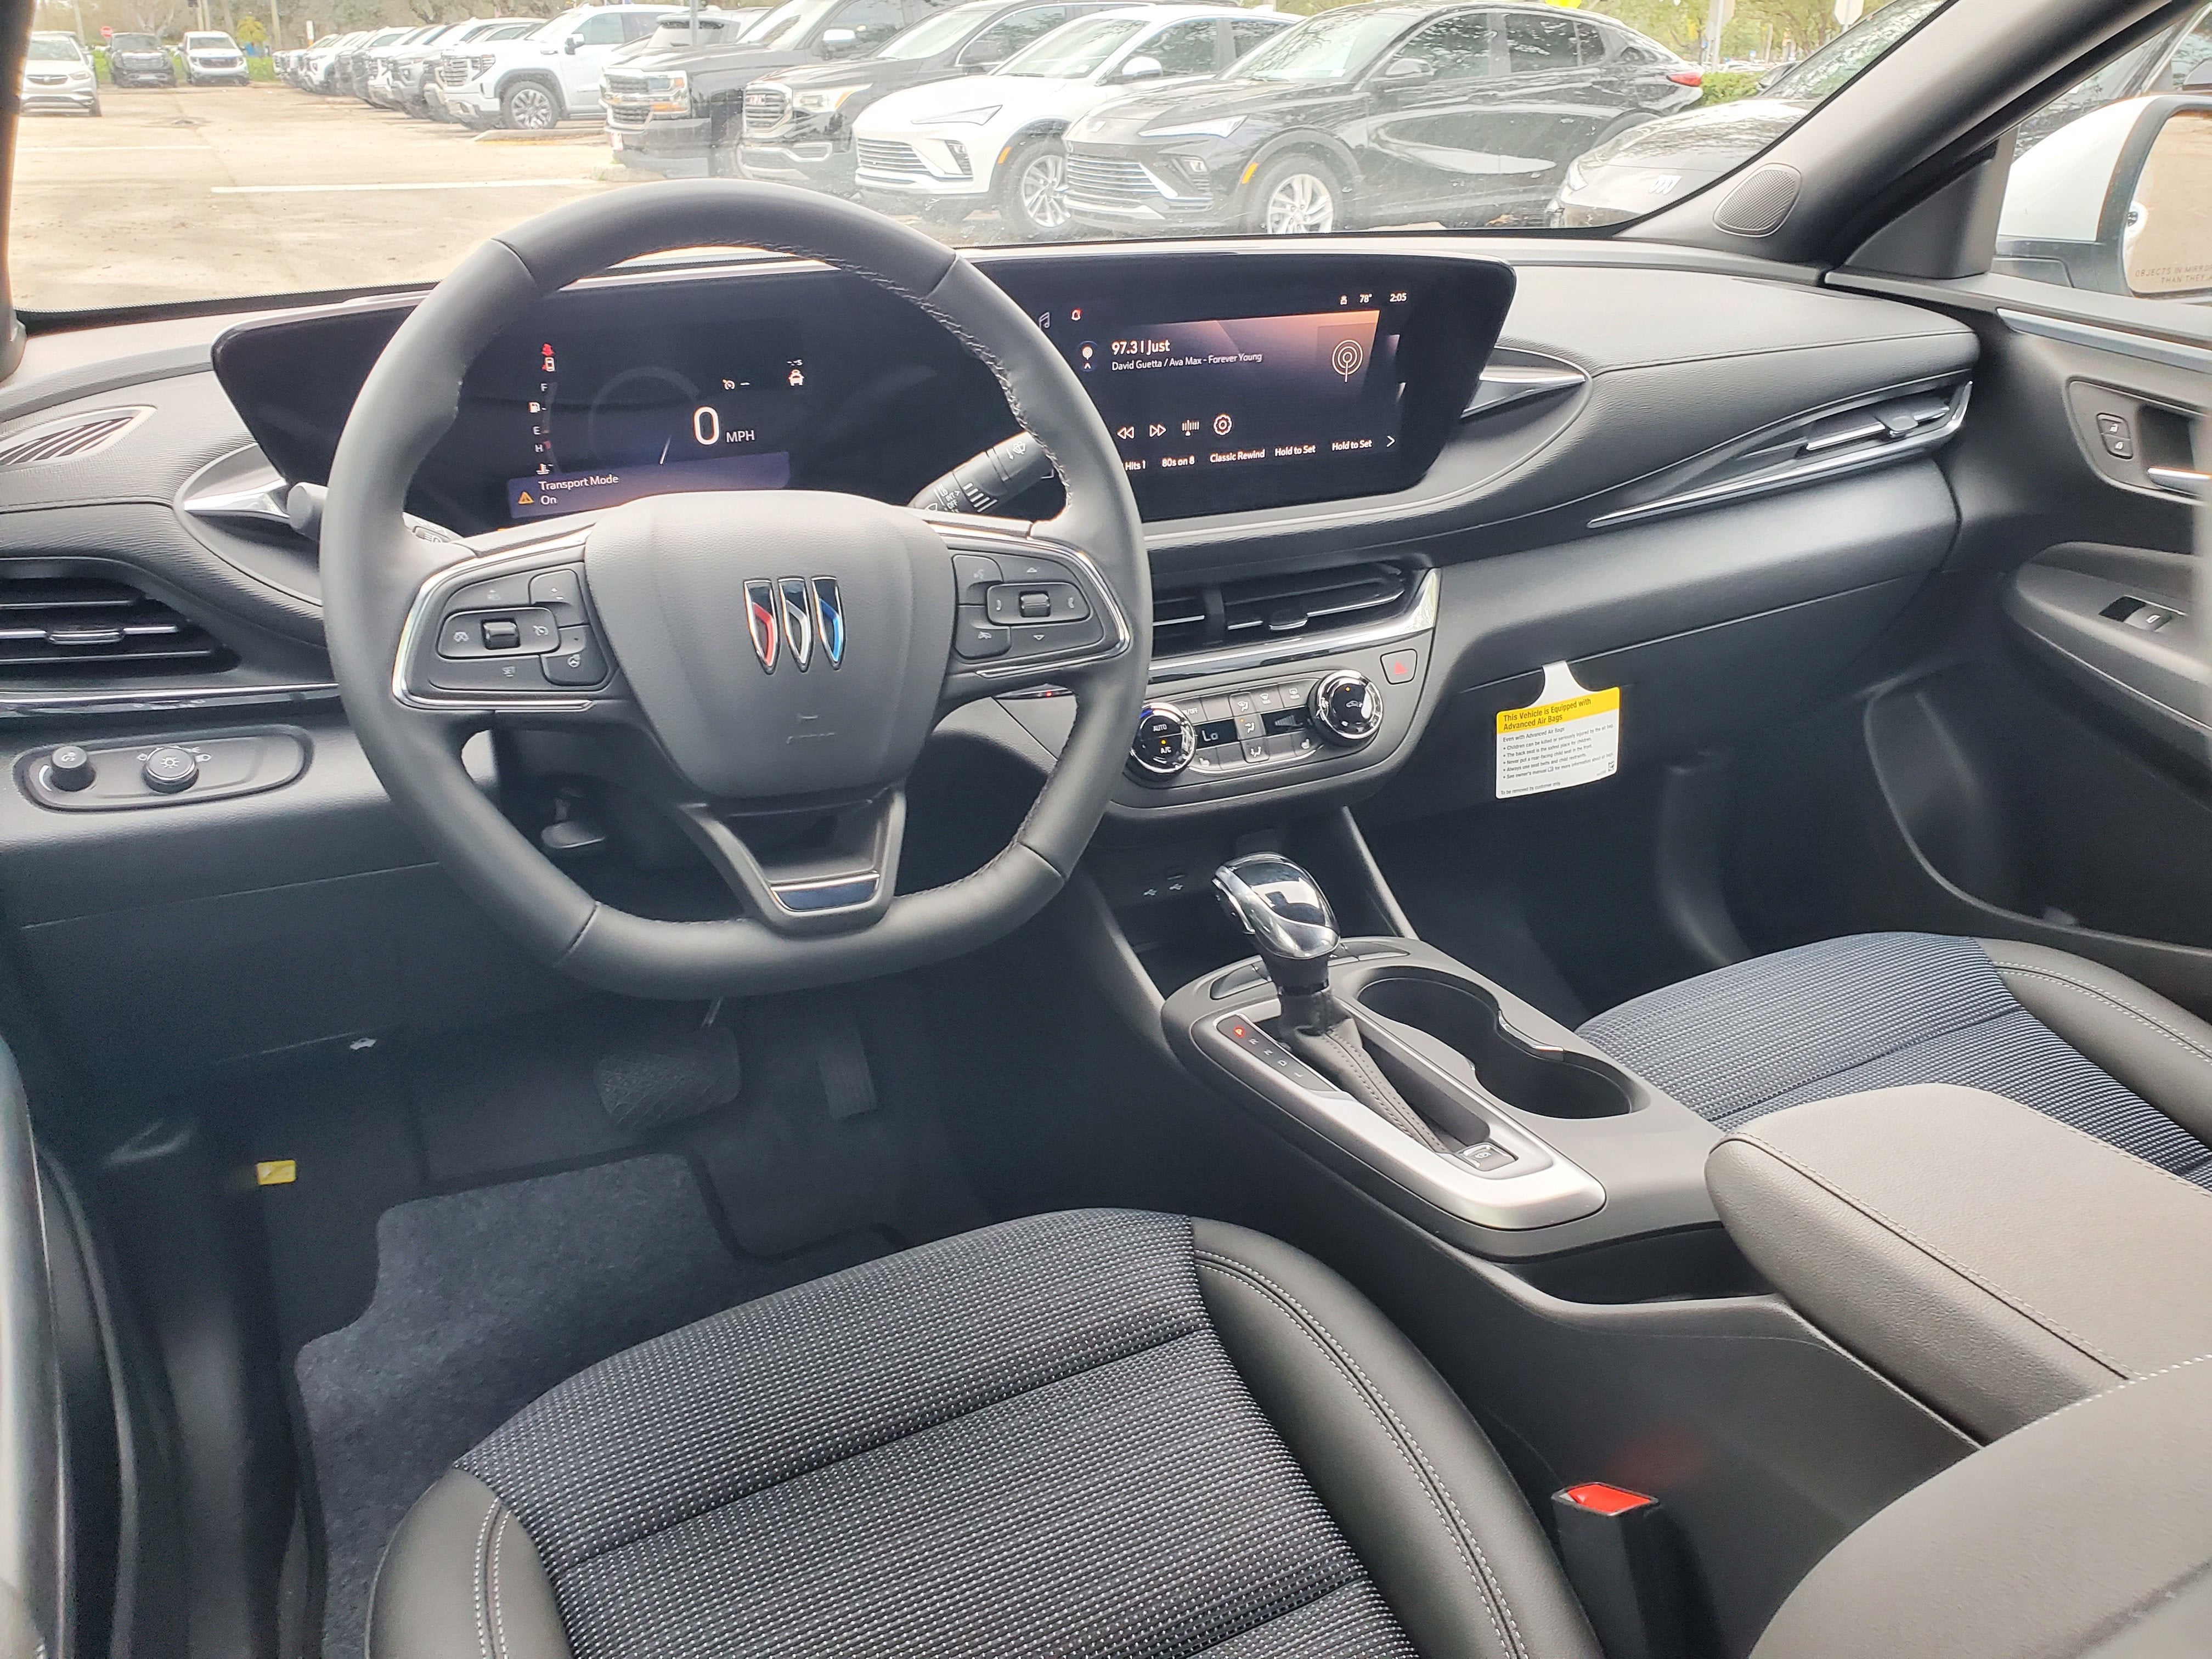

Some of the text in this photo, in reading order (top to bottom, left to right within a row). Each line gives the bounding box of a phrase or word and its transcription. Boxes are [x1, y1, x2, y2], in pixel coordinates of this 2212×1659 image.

[2135, 267, 2171, 278] OBJECTS
[2185, 274, 2205, 283] THEY
[1389, 292, 1407, 302] 2:05
[1111, 340, 1138, 356] 97.3
[1146, 339, 1171, 356] Just
[1111, 359, 1135, 371] David
[1136, 359, 1163, 370] Guetta
[1169, 357, 1183, 366] Ava
[1185, 356, 1202, 365] Max
[1208, 355, 1238, 364] Forever
[1238, 353, 1262, 363] Young
[540, 383, 548, 392] F
[533, 426, 541, 435] E
[693, 406, 755, 445] 0 MPH
[534, 443, 544, 453] H
[1274, 444, 1317, 457] Hold to Set
[1331, 439, 1373, 451] Hold to Set
[1161, 455, 1195, 467] 80s on 8
[1210, 449, 1266, 463] Classic Rewind
[1125, 459, 1146, 471] Hits 1
[538, 474, 619, 490] Transport Mode
[540, 495, 557, 505] On
[945, 492, 955, 502] INT
[947, 499, 958, 509] OFF
[1503, 714, 1517, 722] This
[1519, 710, 1542, 719] Vehicle
[1551, 701, 1577, 713] Equipped
[1578, 698, 1591, 707] with
[1153, 724, 1167, 732] AUTO
[1503, 714, 1562, 731] Advanced Air Bags
[1526, 730, 1547, 738] Advanced
